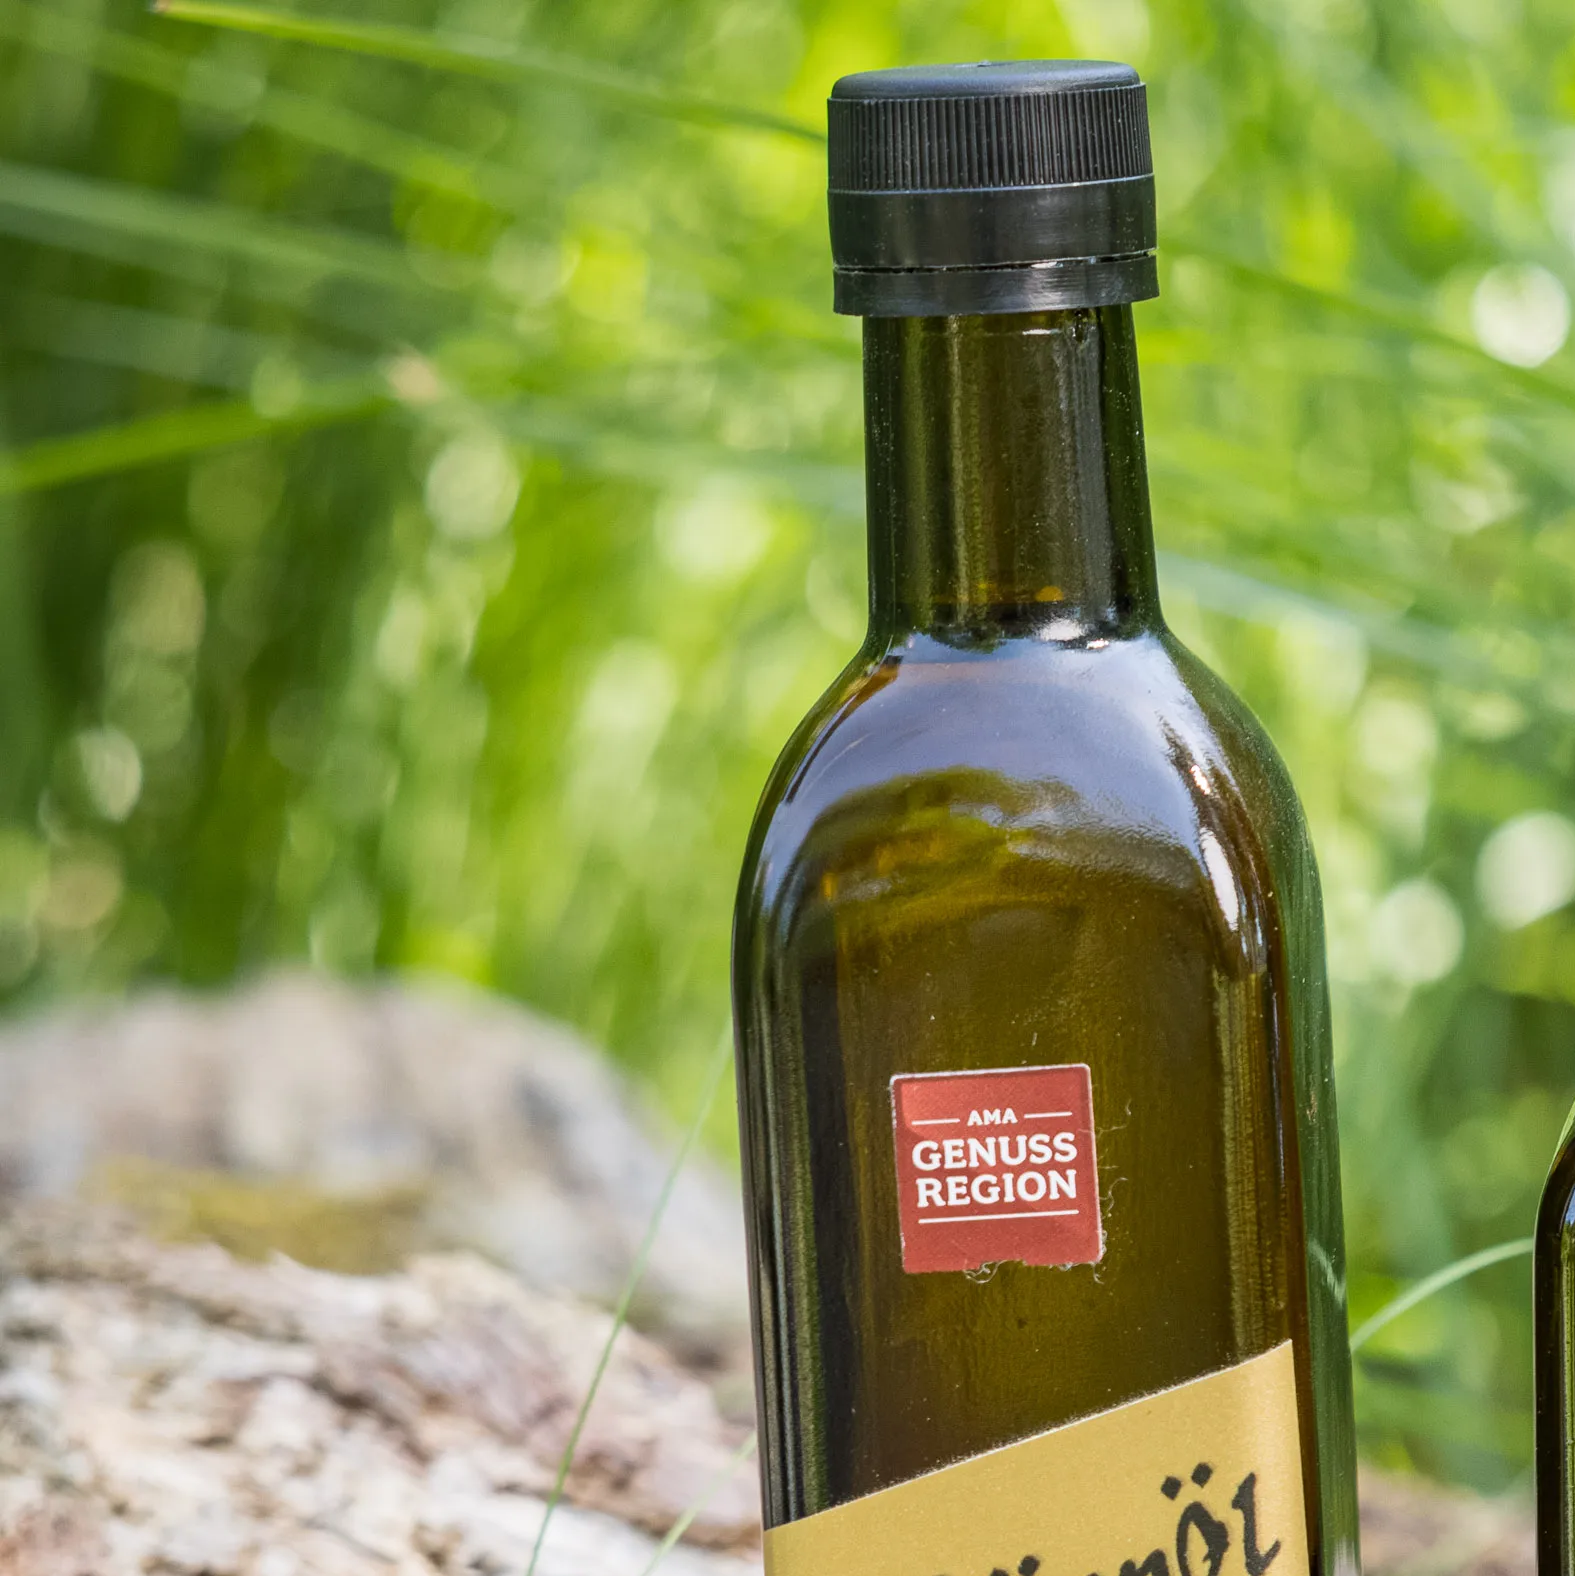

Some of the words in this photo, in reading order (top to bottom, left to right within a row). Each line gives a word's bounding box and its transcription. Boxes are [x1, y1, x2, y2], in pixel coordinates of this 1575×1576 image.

[967, 1108, 1017, 1126] AMA
[912, 1132, 1077, 1170] GENUSS
[916, 1169, 1076, 1207] REGION
